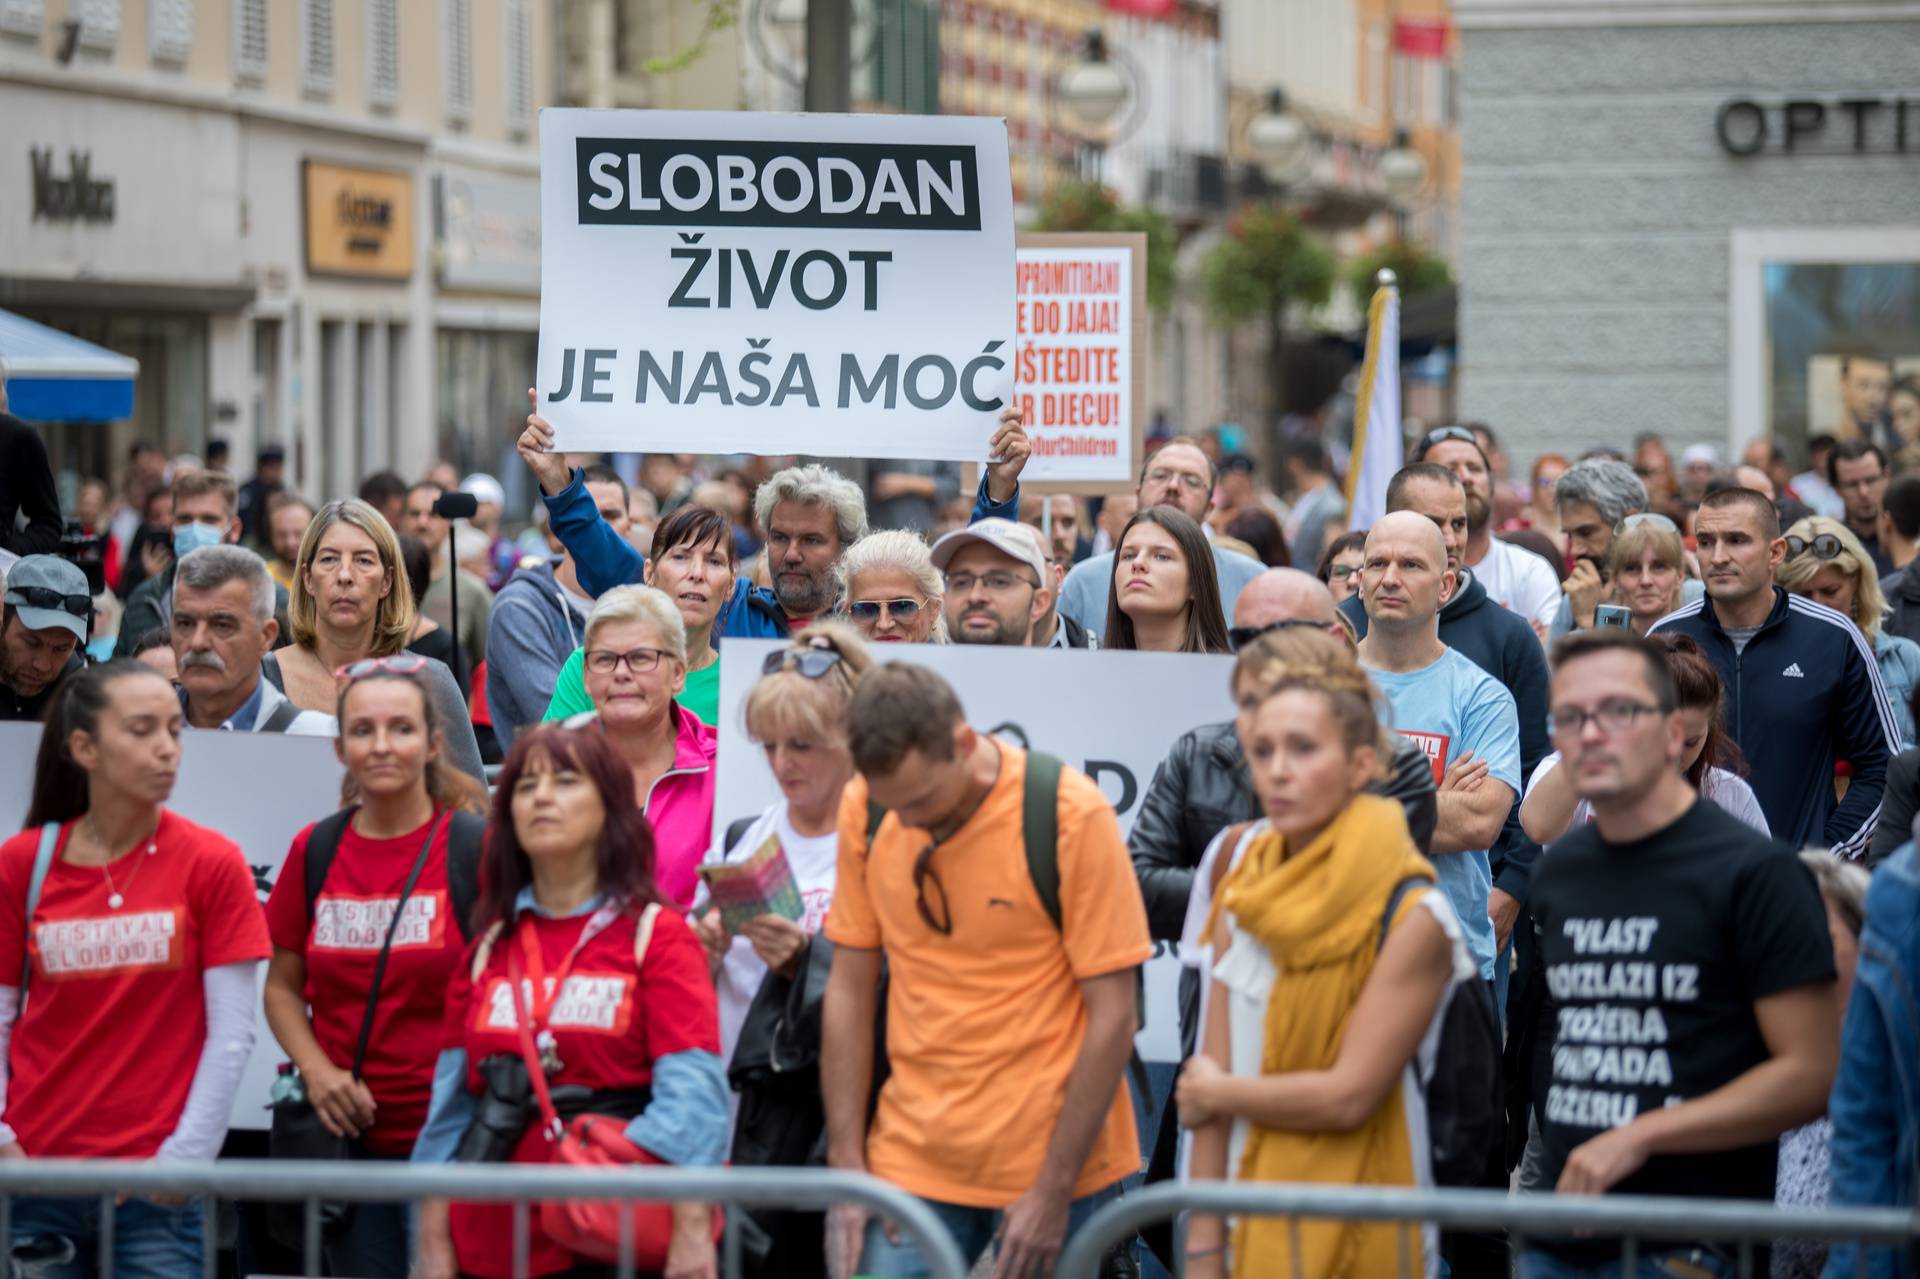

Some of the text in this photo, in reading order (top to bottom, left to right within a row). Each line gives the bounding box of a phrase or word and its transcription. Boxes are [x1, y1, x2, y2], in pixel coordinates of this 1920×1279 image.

[1715, 99, 1907, 154] OPTI
[588, 152, 966, 217] SLOBODAN
[668, 232, 893, 311] ŽIVOT
[1033, 301, 1060, 335] DO
[1067, 301, 1119, 335] JAJA!
[548, 338, 1007, 412] JE NAŠA MOĆ
[1042, 393, 1119, 426] DJECU!
[318, 922, 426, 945] SLOBDE
[1661, 963, 1699, 1000] IZ
